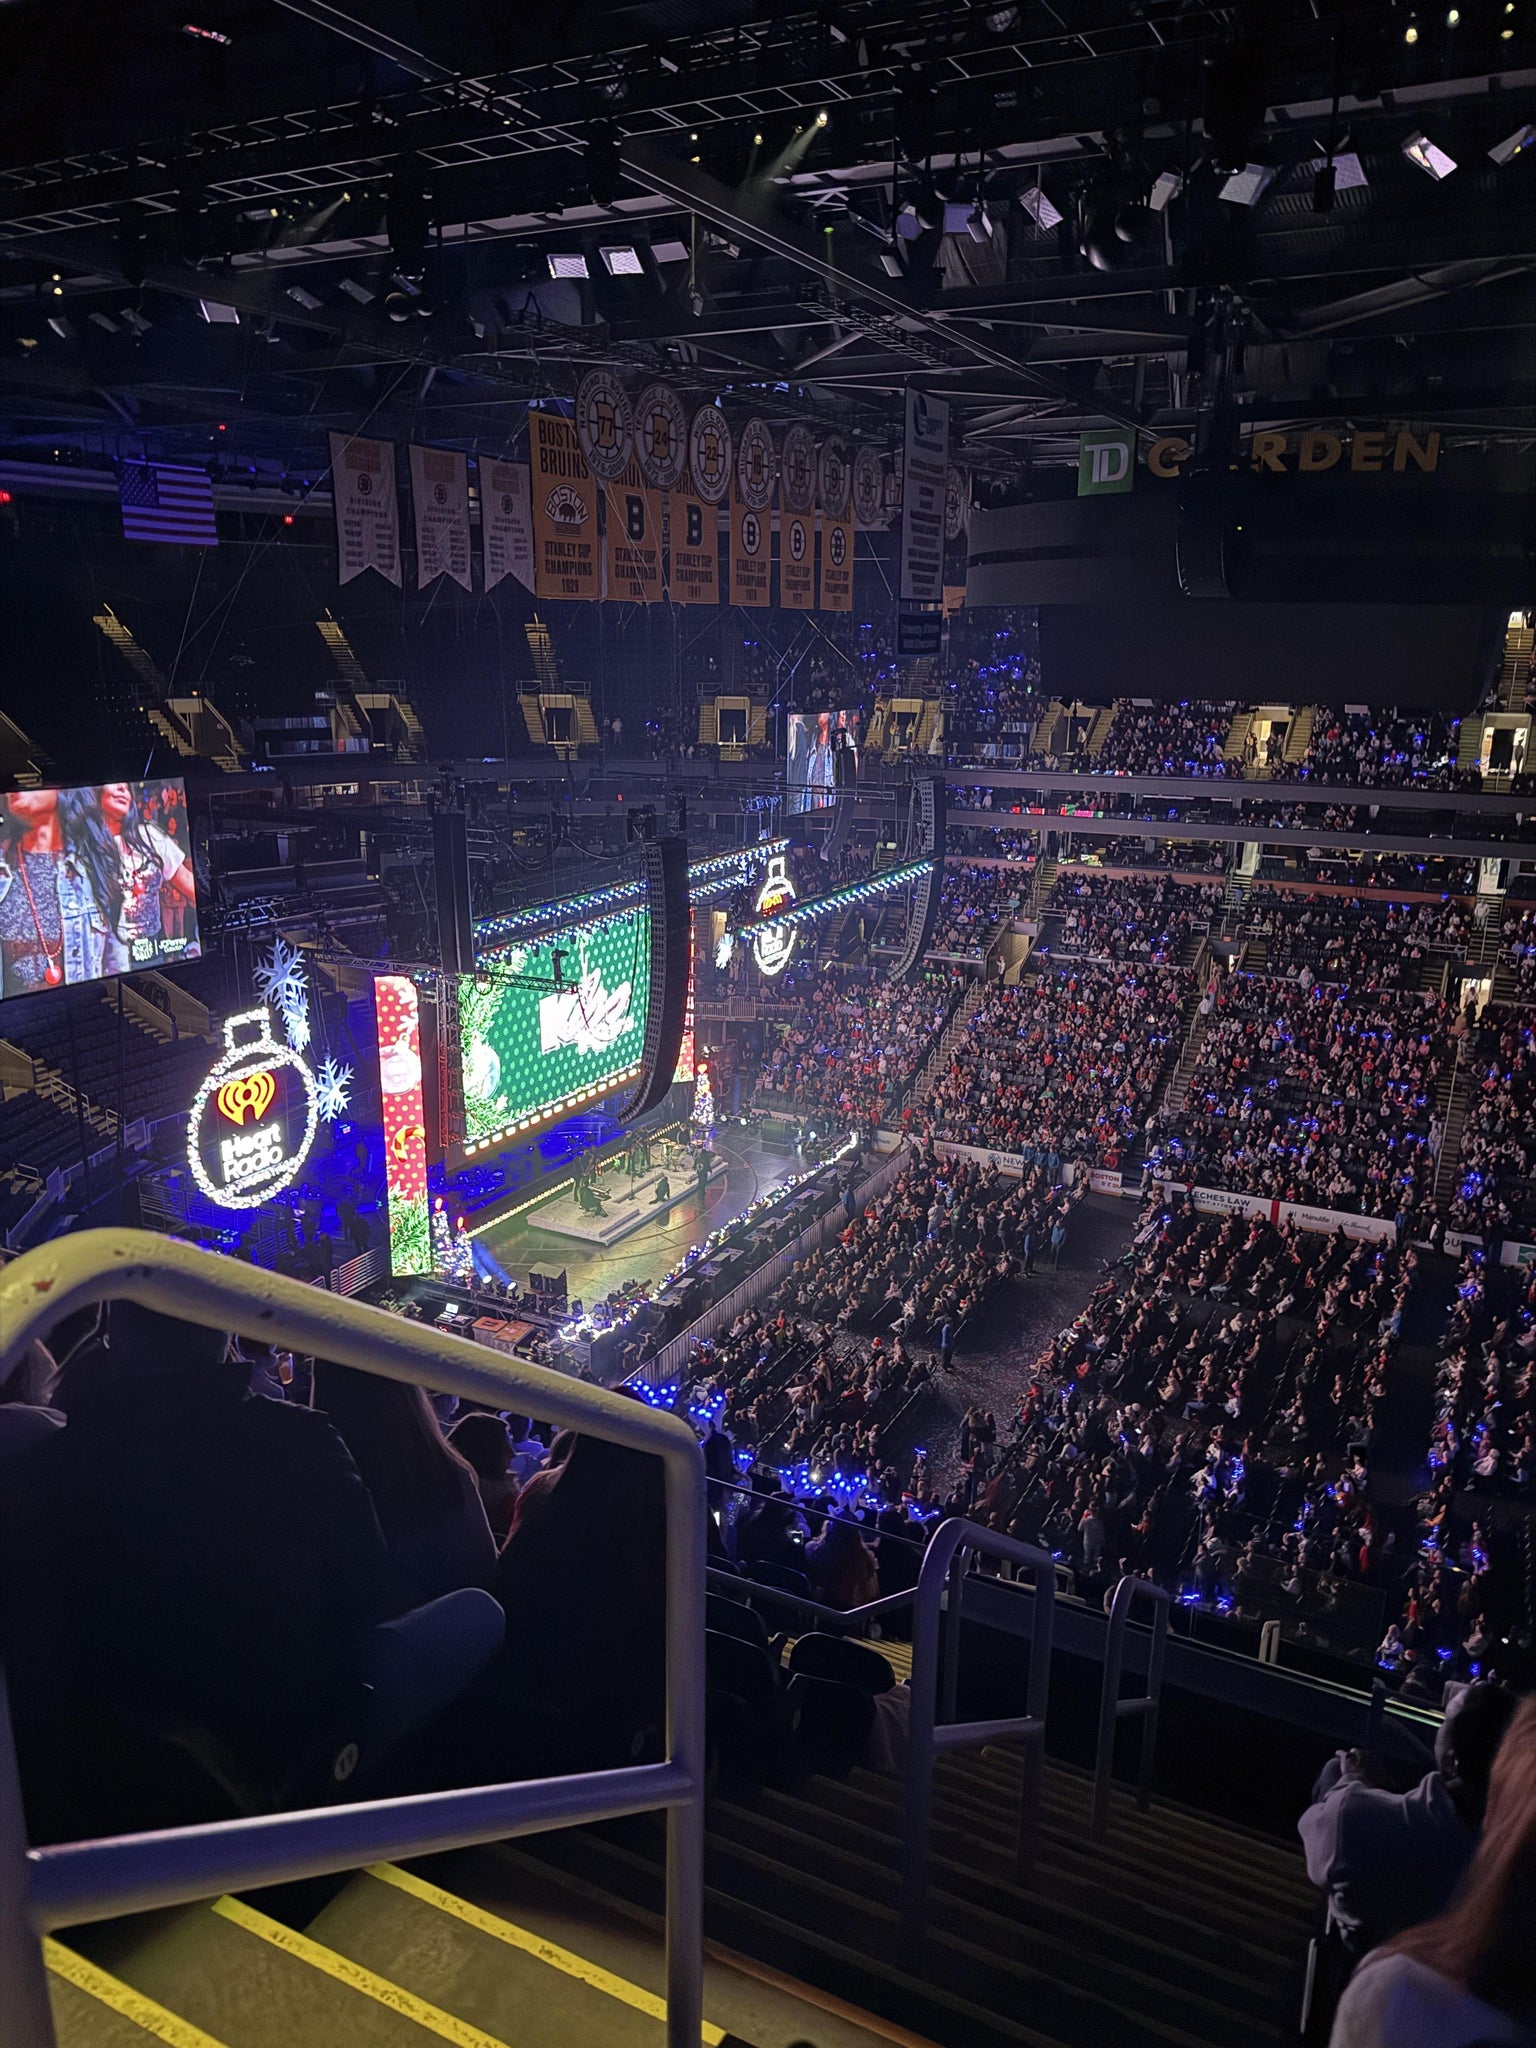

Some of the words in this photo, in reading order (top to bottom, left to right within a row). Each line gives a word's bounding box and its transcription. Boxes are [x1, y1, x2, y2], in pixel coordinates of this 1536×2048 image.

[538, 418, 580, 450] BOSTO
[600, 416, 615, 437] 77
[654, 430, 668, 447] 24
[540, 447, 589, 479] BRUINS
[707, 446, 717, 461] 22
[1085, 442, 1130, 483] TD
[1149, 432, 1441, 477] GRDEN
[546, 486, 588, 521] BOSTON
[545, 541, 576, 558] STANLEY
[578, 544, 591, 557] CUP
[545, 560, 593, 576] CHAMPIONS
[1193, 1191, 1226, 1203] ECHES
[1227, 1197, 1250, 1207] LAW
[1302, 1213, 1331, 1223] Manulife
